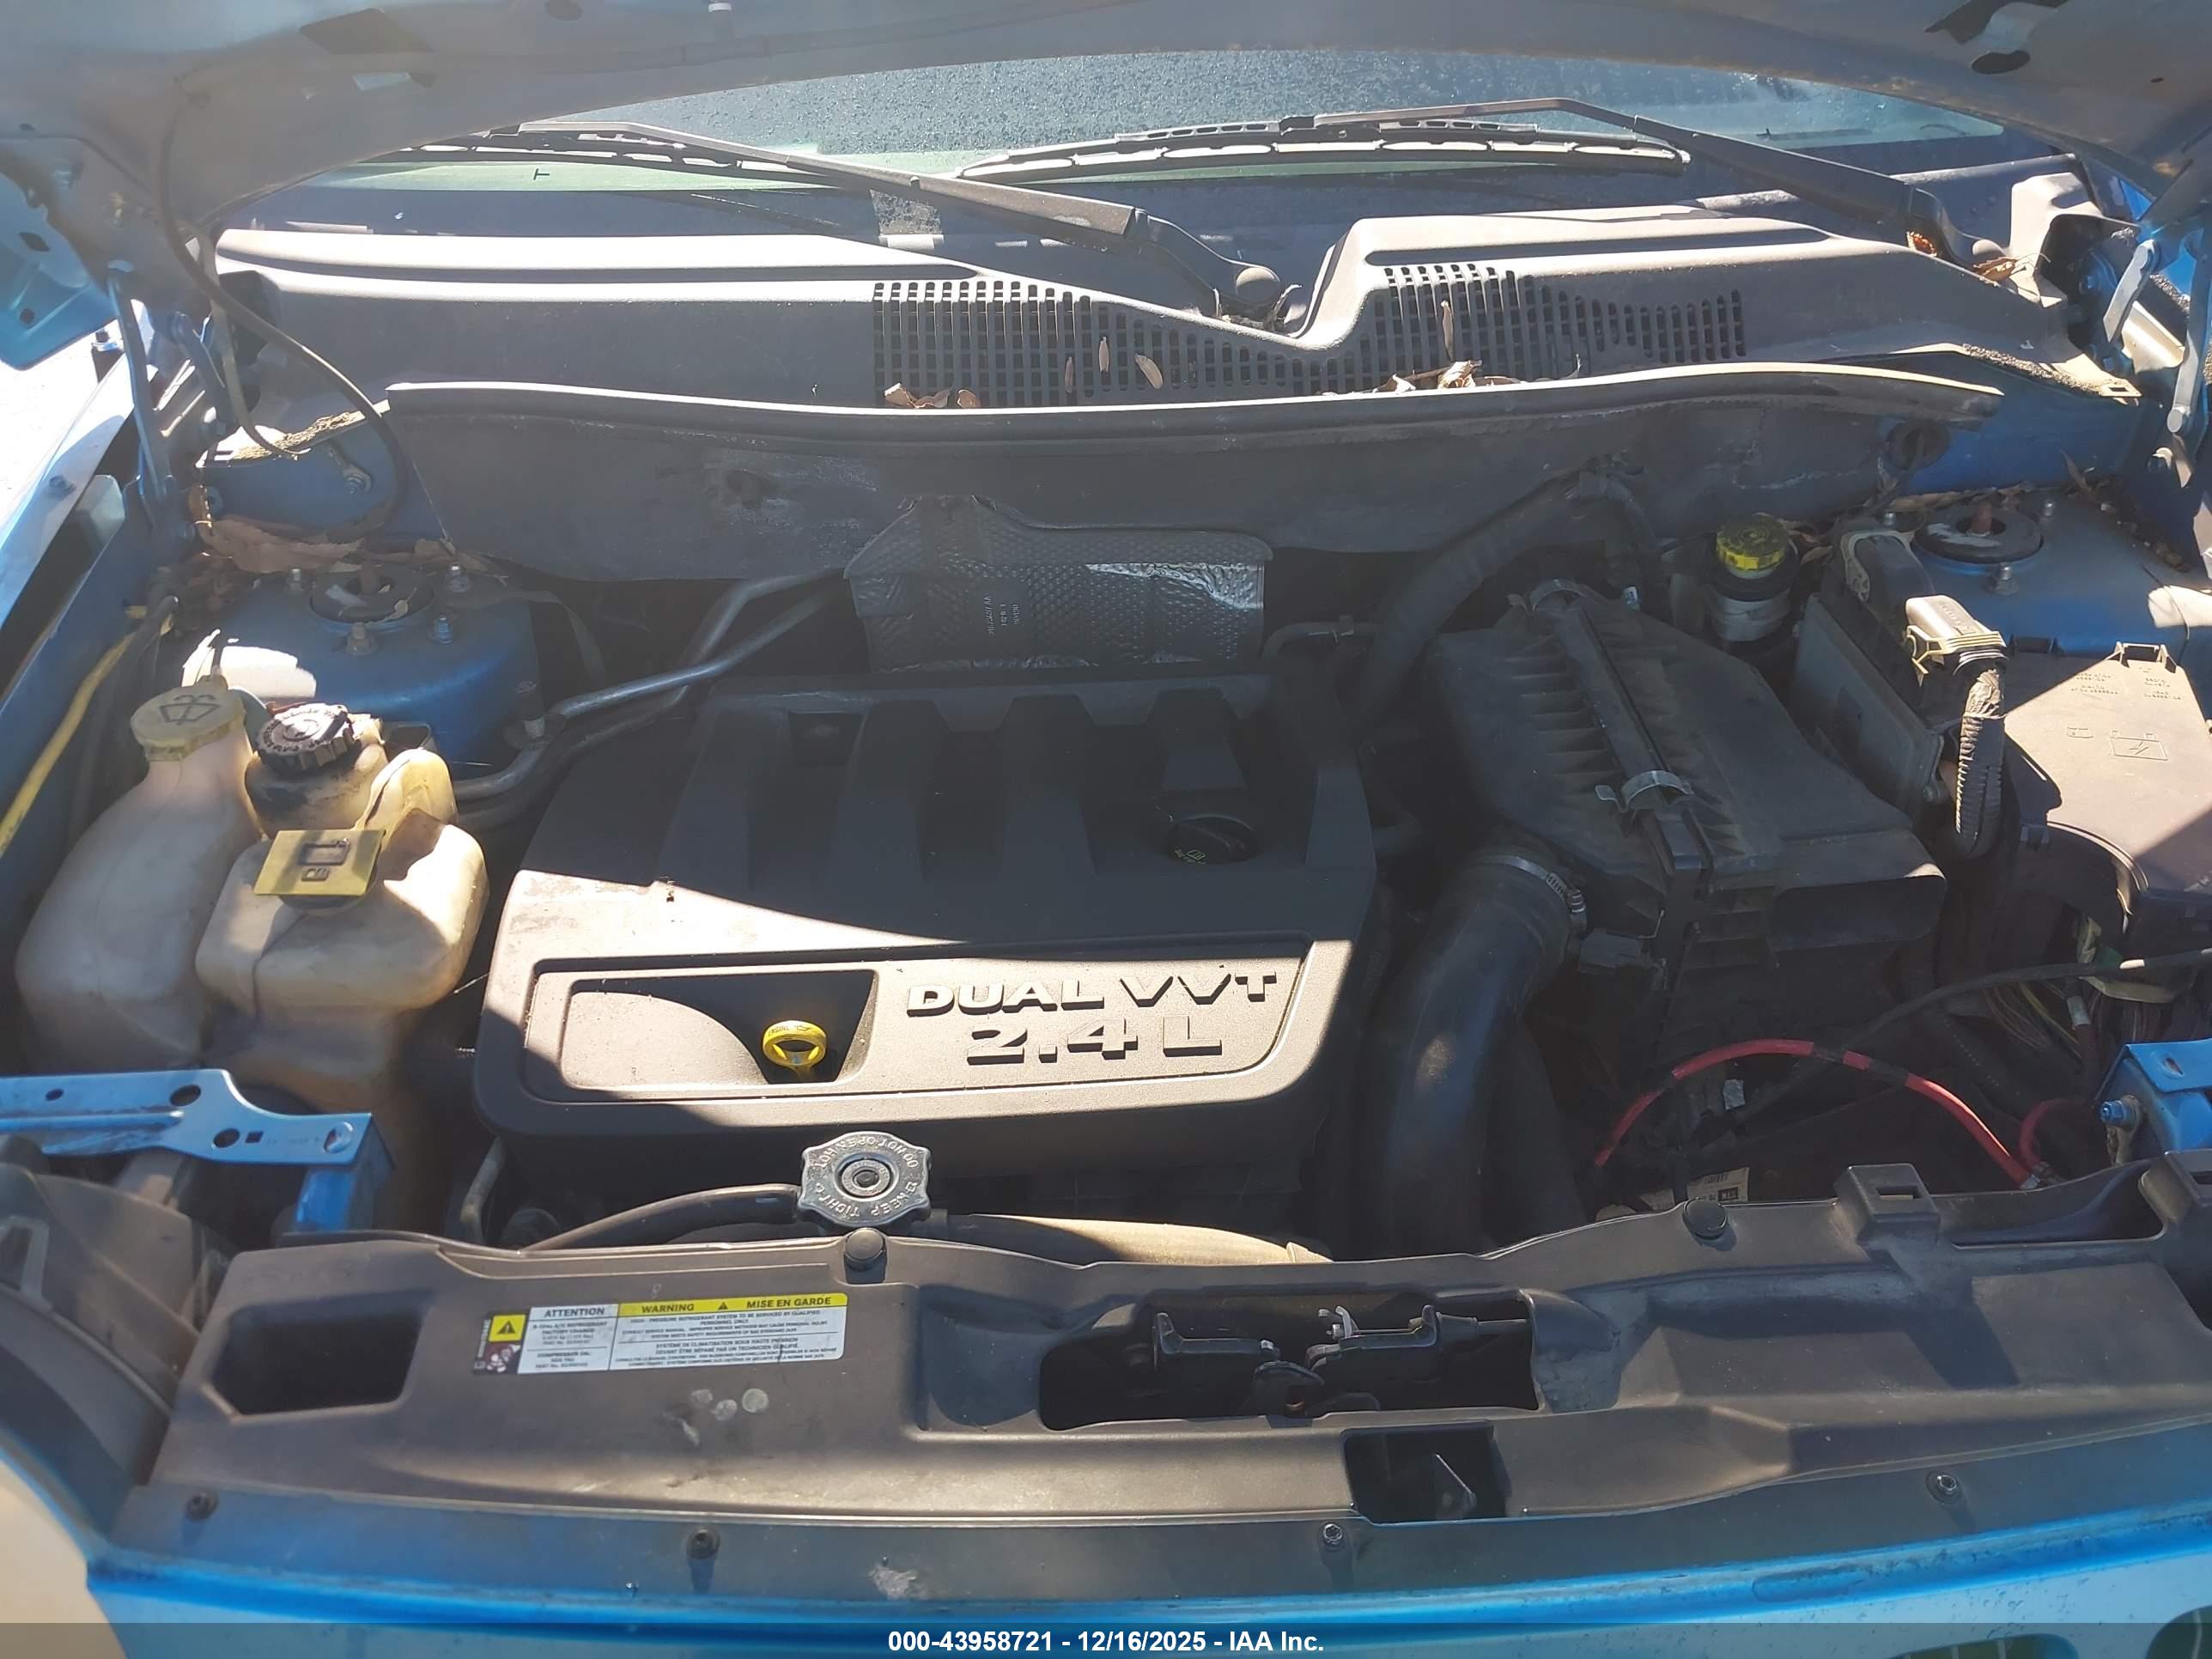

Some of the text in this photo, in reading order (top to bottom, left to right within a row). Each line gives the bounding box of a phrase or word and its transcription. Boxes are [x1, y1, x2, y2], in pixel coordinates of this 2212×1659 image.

[906, 971, 1277, 1017] DUAL VVT
[837, 1136, 875, 1149] OPEN
[544, 1307, 605, 1316] ATTENTION
[641, 1304, 694, 1312] WARNING
